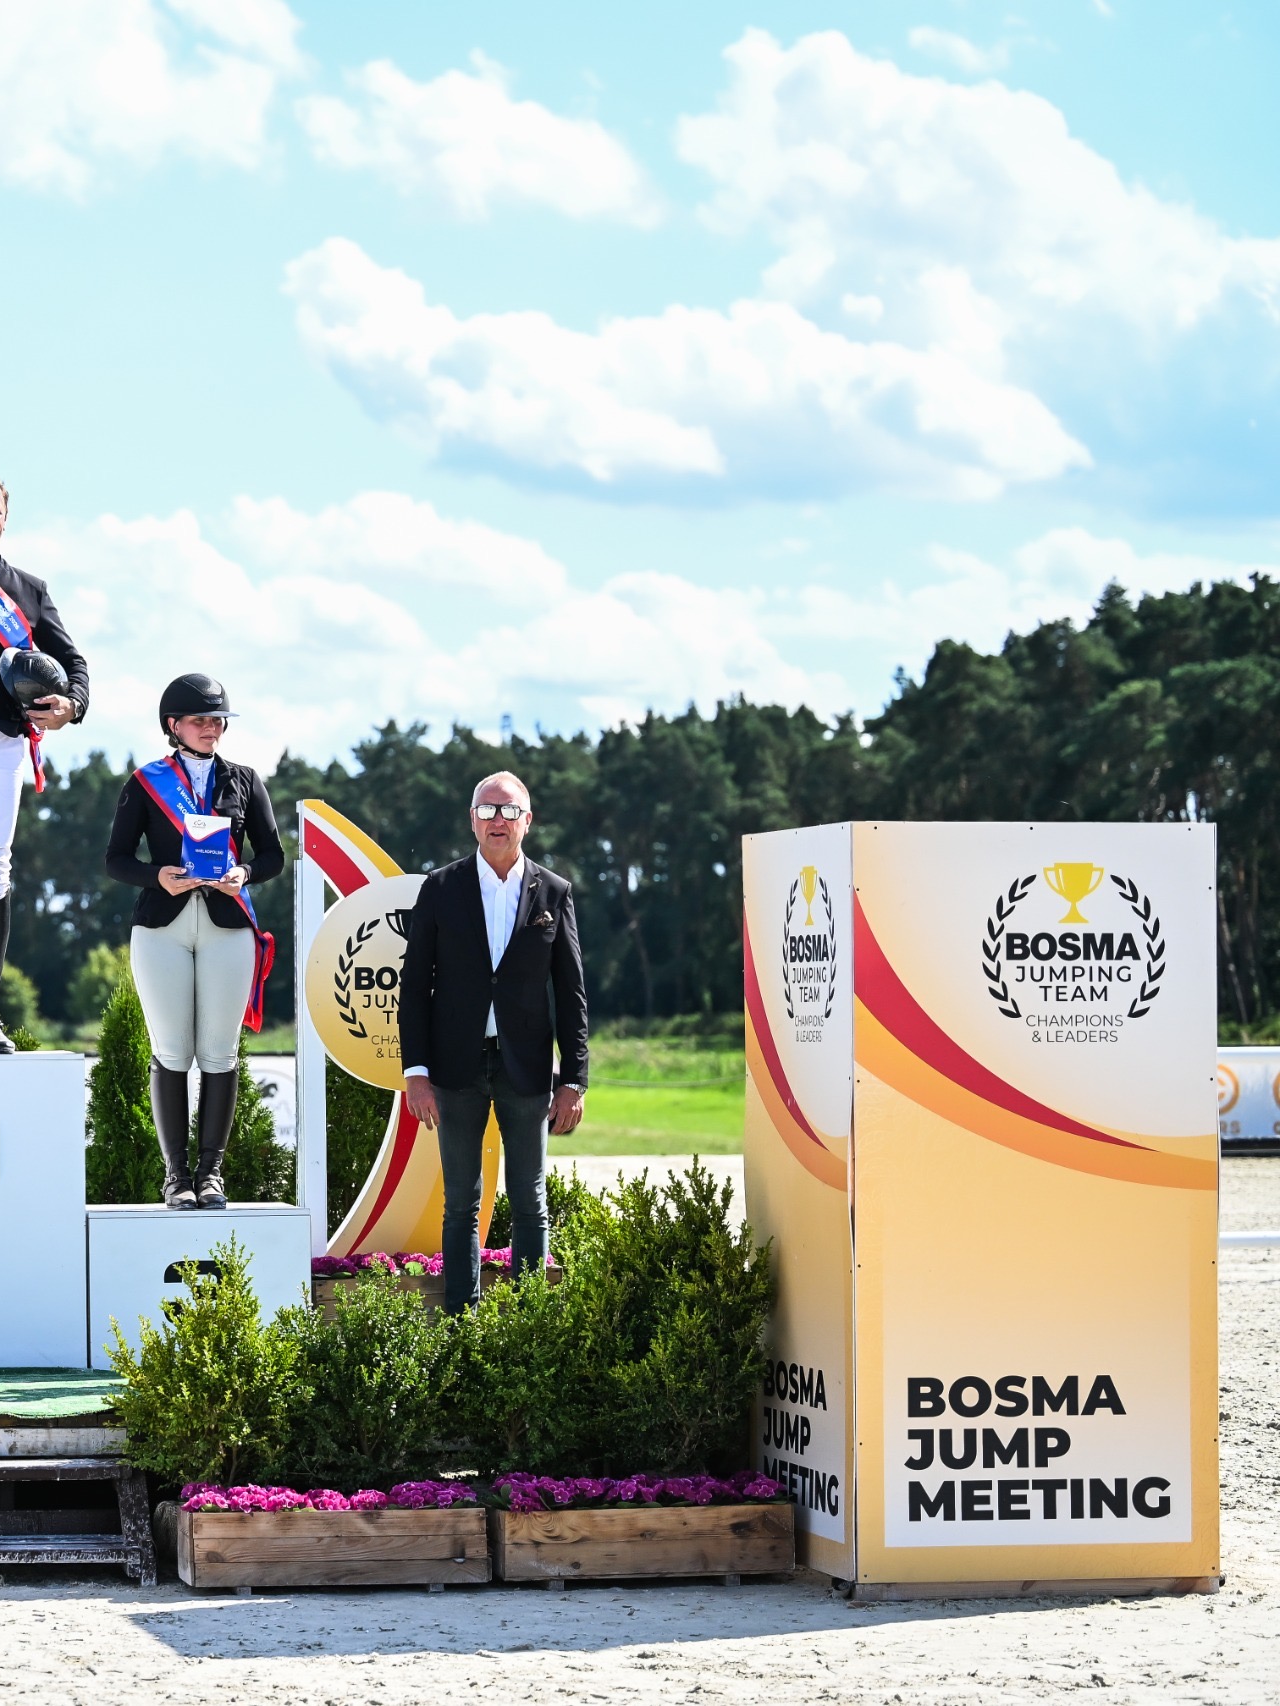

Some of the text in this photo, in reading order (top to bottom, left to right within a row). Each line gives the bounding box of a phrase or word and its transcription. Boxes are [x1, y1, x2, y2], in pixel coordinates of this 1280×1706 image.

[789, 934, 829, 963] BOSMA
[1006, 932, 1141, 961] BOSMA
[792, 967, 827, 984] JUMPING
[1015, 966, 1131, 982] JUMPING
[799, 986, 820, 1002] TEAM
[1039, 985, 1108, 1001] TEAM
[795, 1014, 824, 1027] CHAMPIONS
[1026, 1014, 1124, 1027] CHAMPIONS
[800, 1030, 822, 1042] LEADERS
[1031, 1031, 1118, 1042] & LEADERS
[763, 1359, 827, 1411] BOSMA
[907, 1374, 1127, 1418] BOSMA
[763, 1406, 811, 1455] JUMP
[904, 1428, 1071, 1471] JUMP
[908, 1476, 1171, 1522] MEETING
